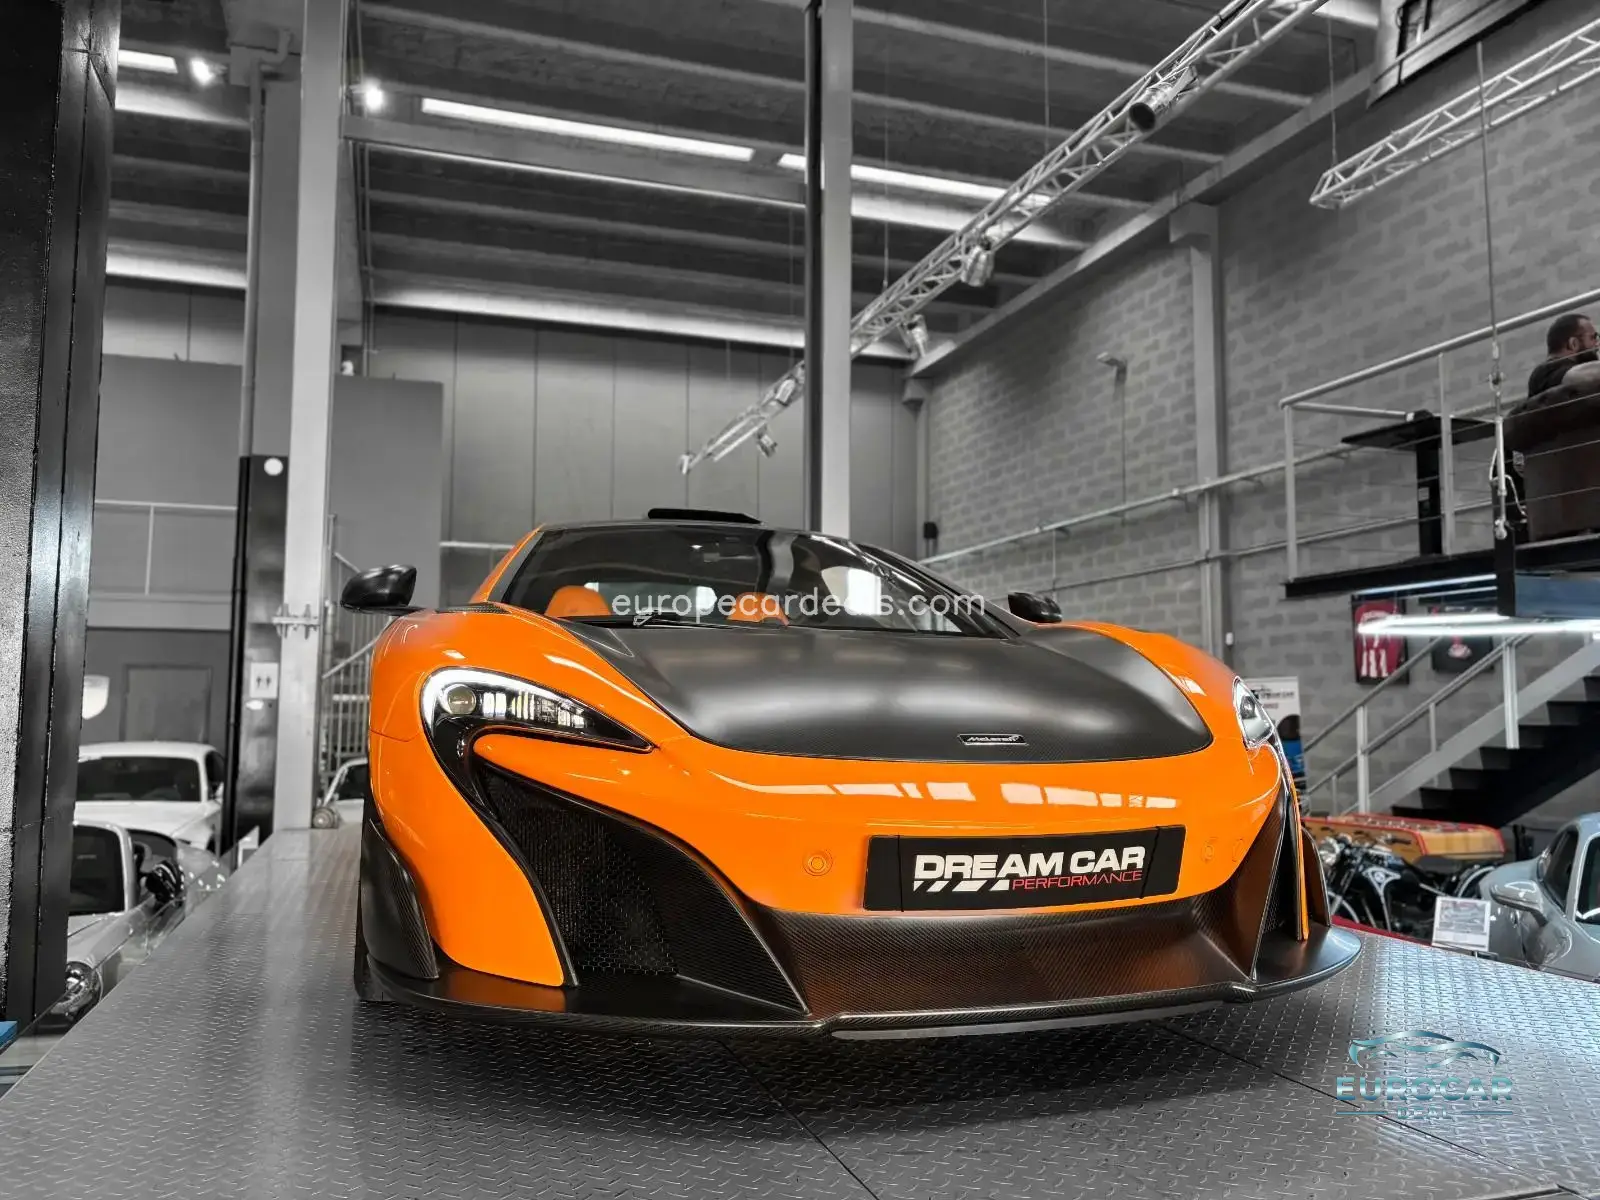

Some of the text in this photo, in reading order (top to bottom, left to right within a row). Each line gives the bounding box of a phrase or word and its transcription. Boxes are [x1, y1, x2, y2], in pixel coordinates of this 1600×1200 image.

[914, 846, 1145, 879] DREAM CAR
[1012, 870, 1143, 890] PERFORMANCE
